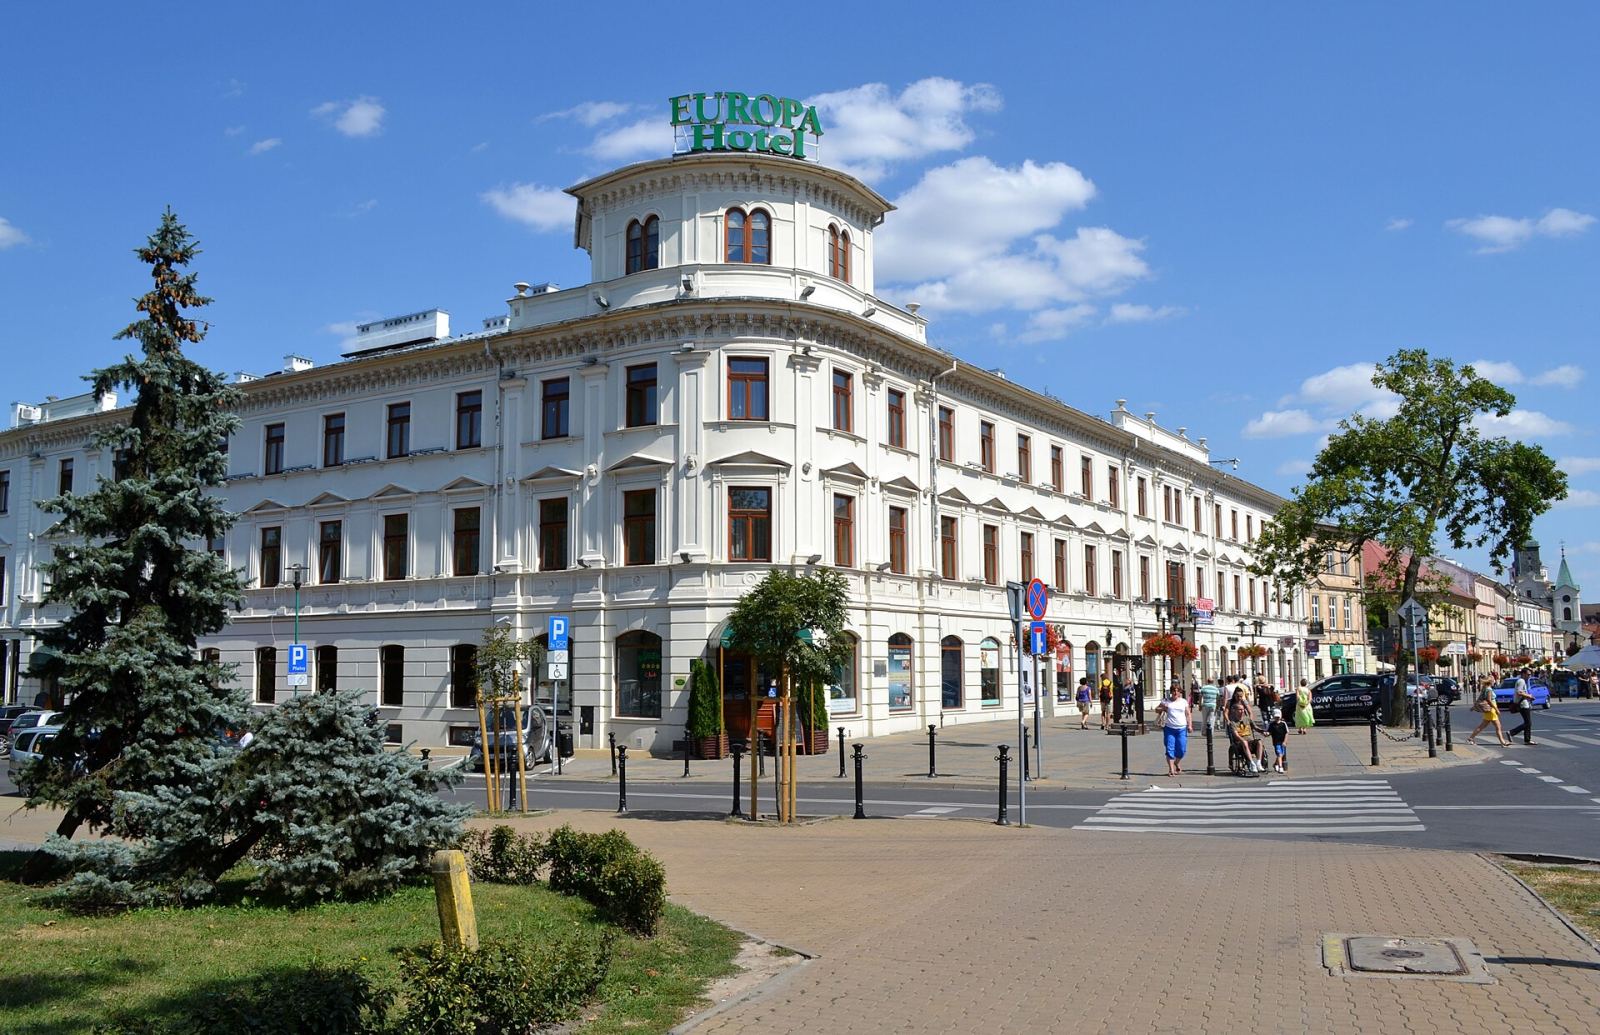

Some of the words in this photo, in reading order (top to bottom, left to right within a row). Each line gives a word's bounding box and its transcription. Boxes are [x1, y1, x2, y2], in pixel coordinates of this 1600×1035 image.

[669, 91, 824, 136] EUROPA
[691, 122, 807, 158] Hotel
[553, 619, 564, 640] P
[292, 646, 304, 665] P
[1335, 694, 1358, 702] dealer
